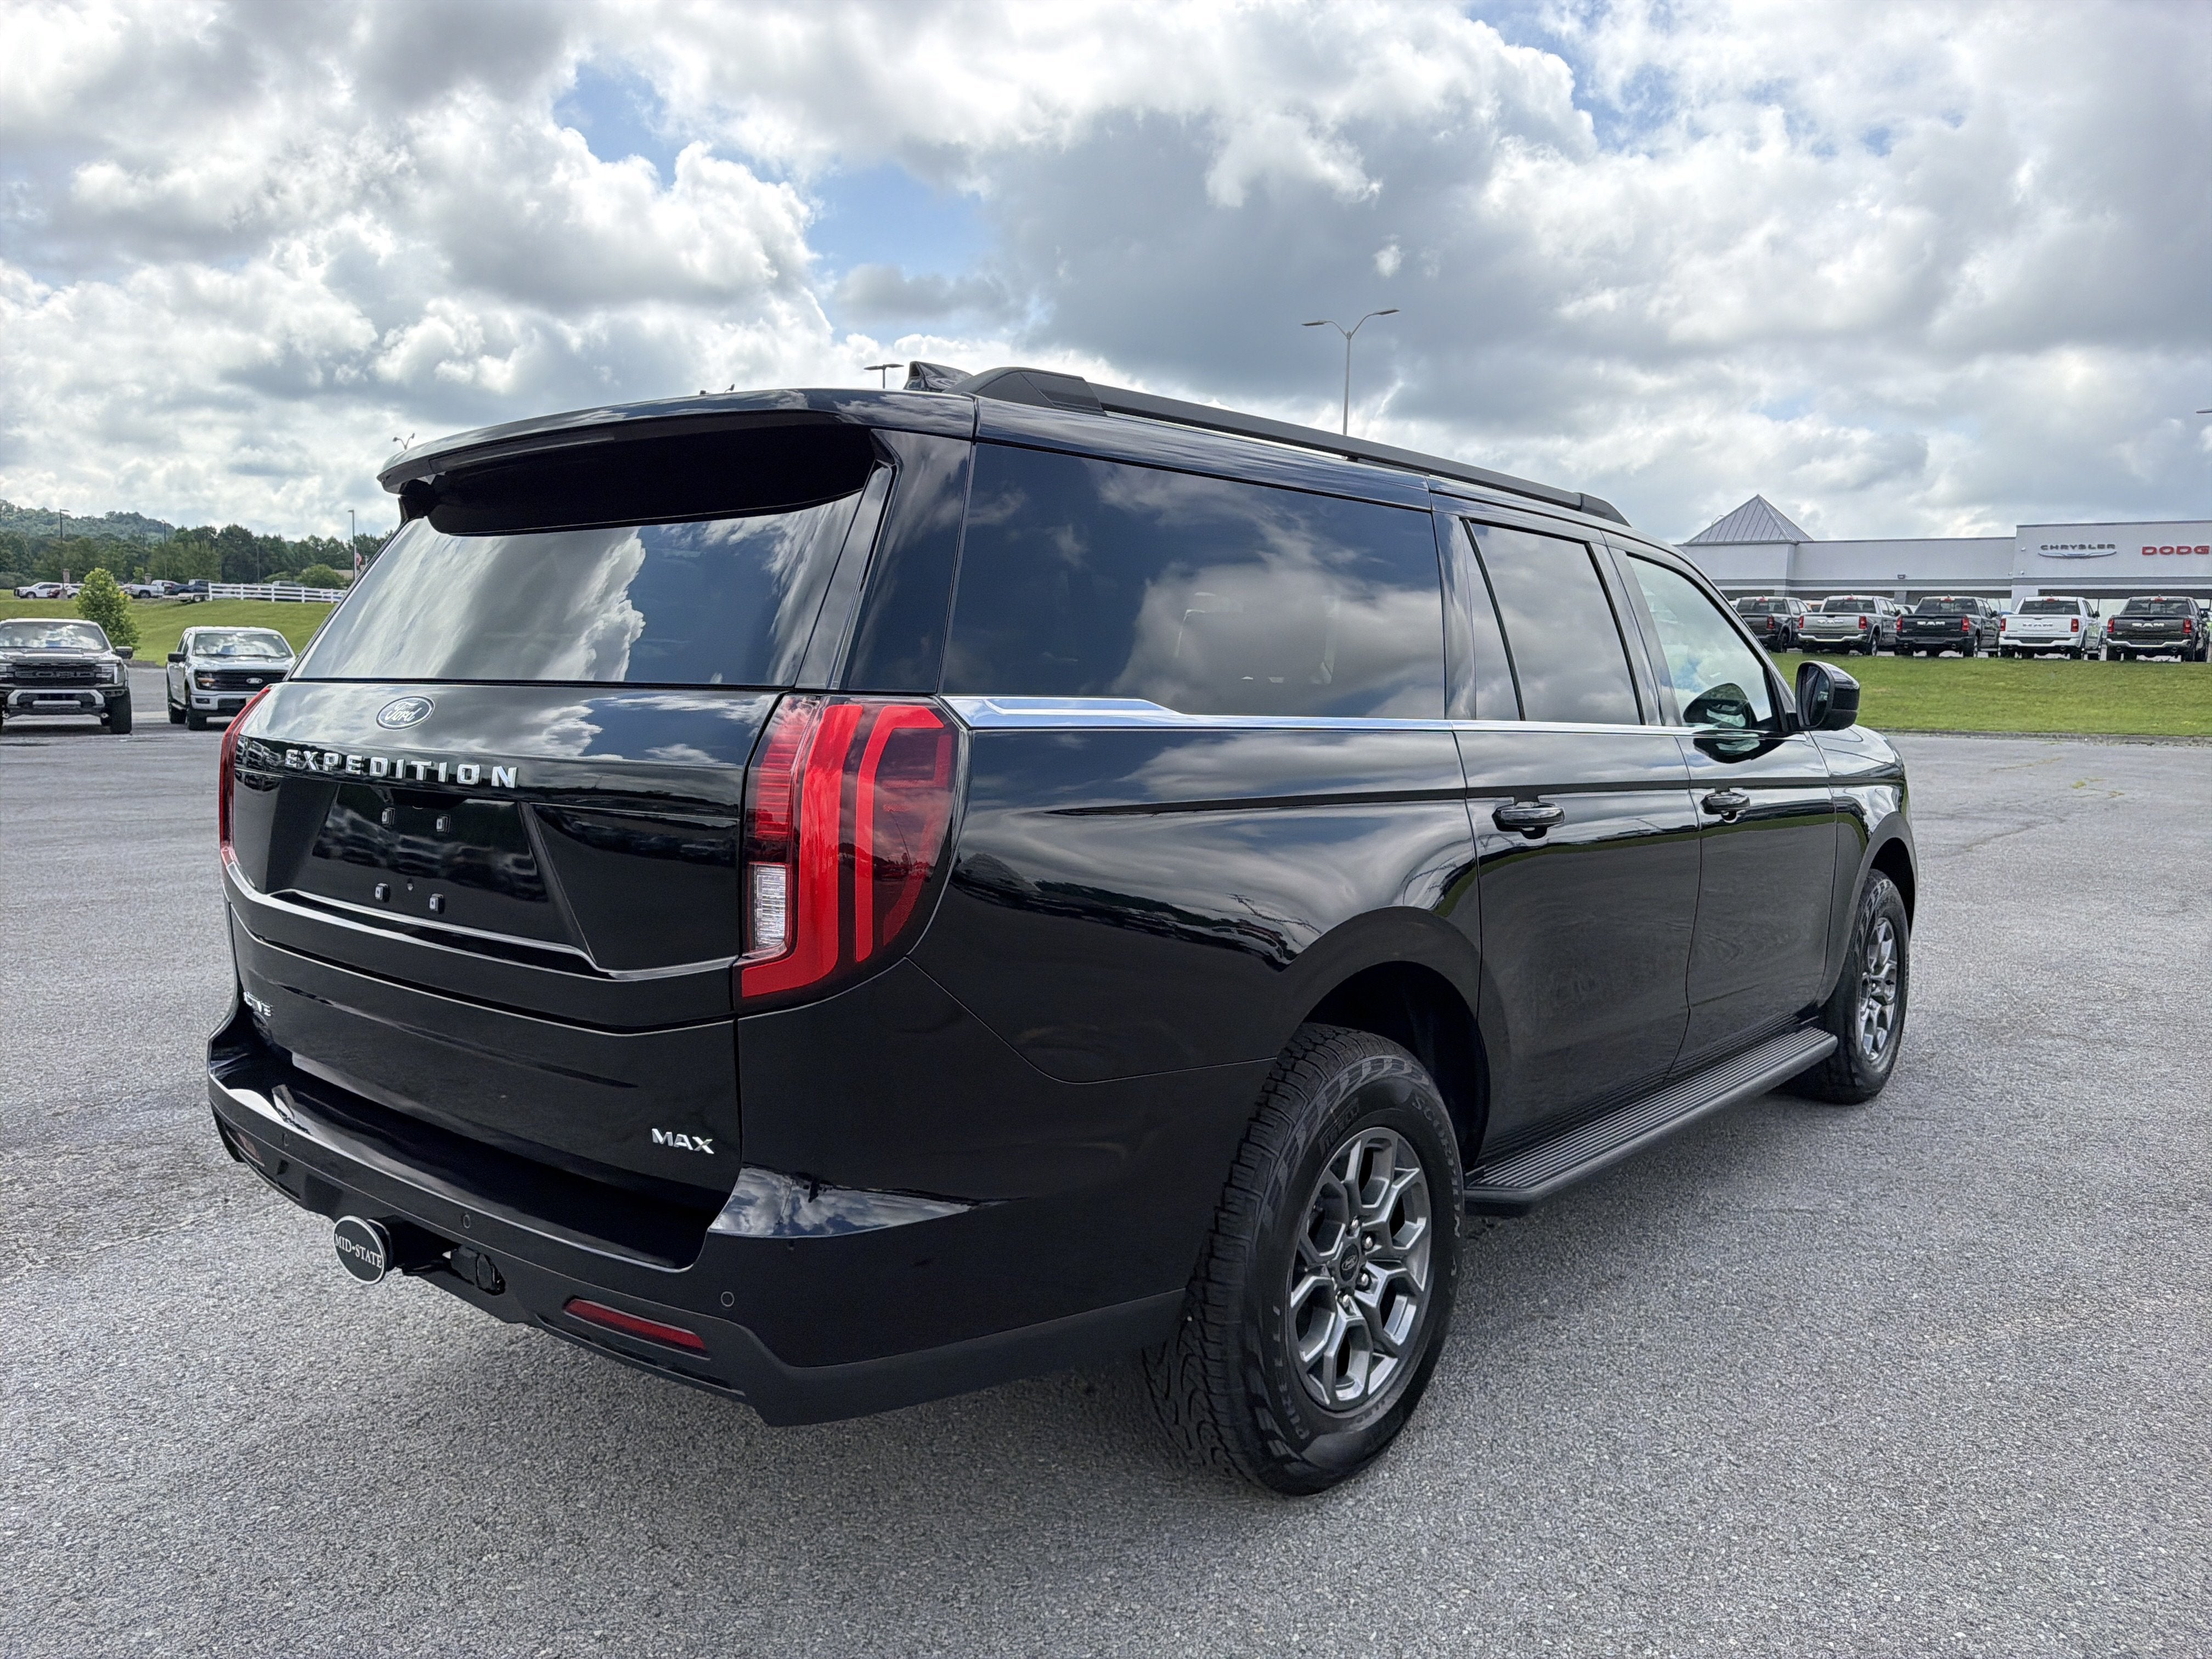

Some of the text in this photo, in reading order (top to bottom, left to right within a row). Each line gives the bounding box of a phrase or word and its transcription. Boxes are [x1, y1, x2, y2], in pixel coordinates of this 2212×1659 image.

[285, 749, 518, 789] EXPEDITION
[652, 1128, 714, 1154] MAX
[335, 1233, 382, 1268] MID-STATE
